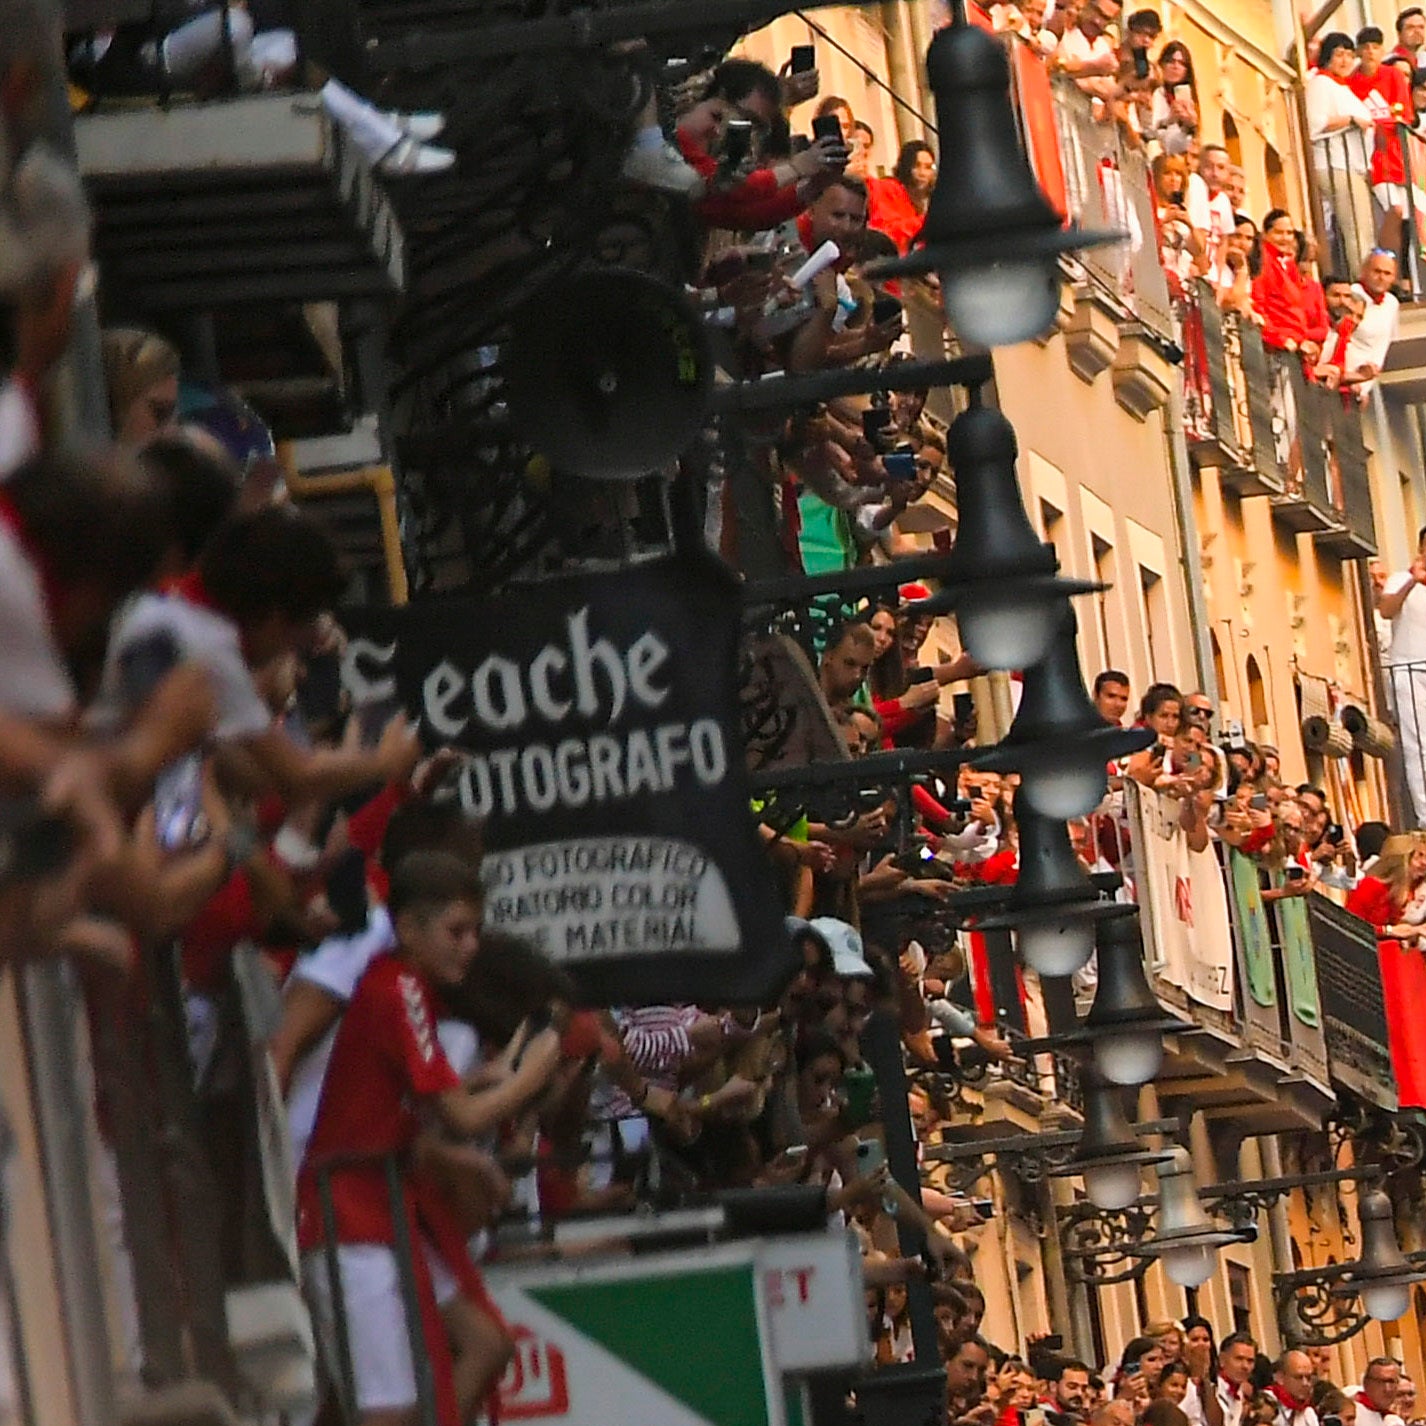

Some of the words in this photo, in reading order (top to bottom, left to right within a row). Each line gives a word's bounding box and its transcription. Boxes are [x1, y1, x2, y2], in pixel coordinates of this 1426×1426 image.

[432, 718, 728, 820] OTOGRAFO
[611, 879, 699, 912] COLOR
[565, 912, 702, 953] MATERIAL
